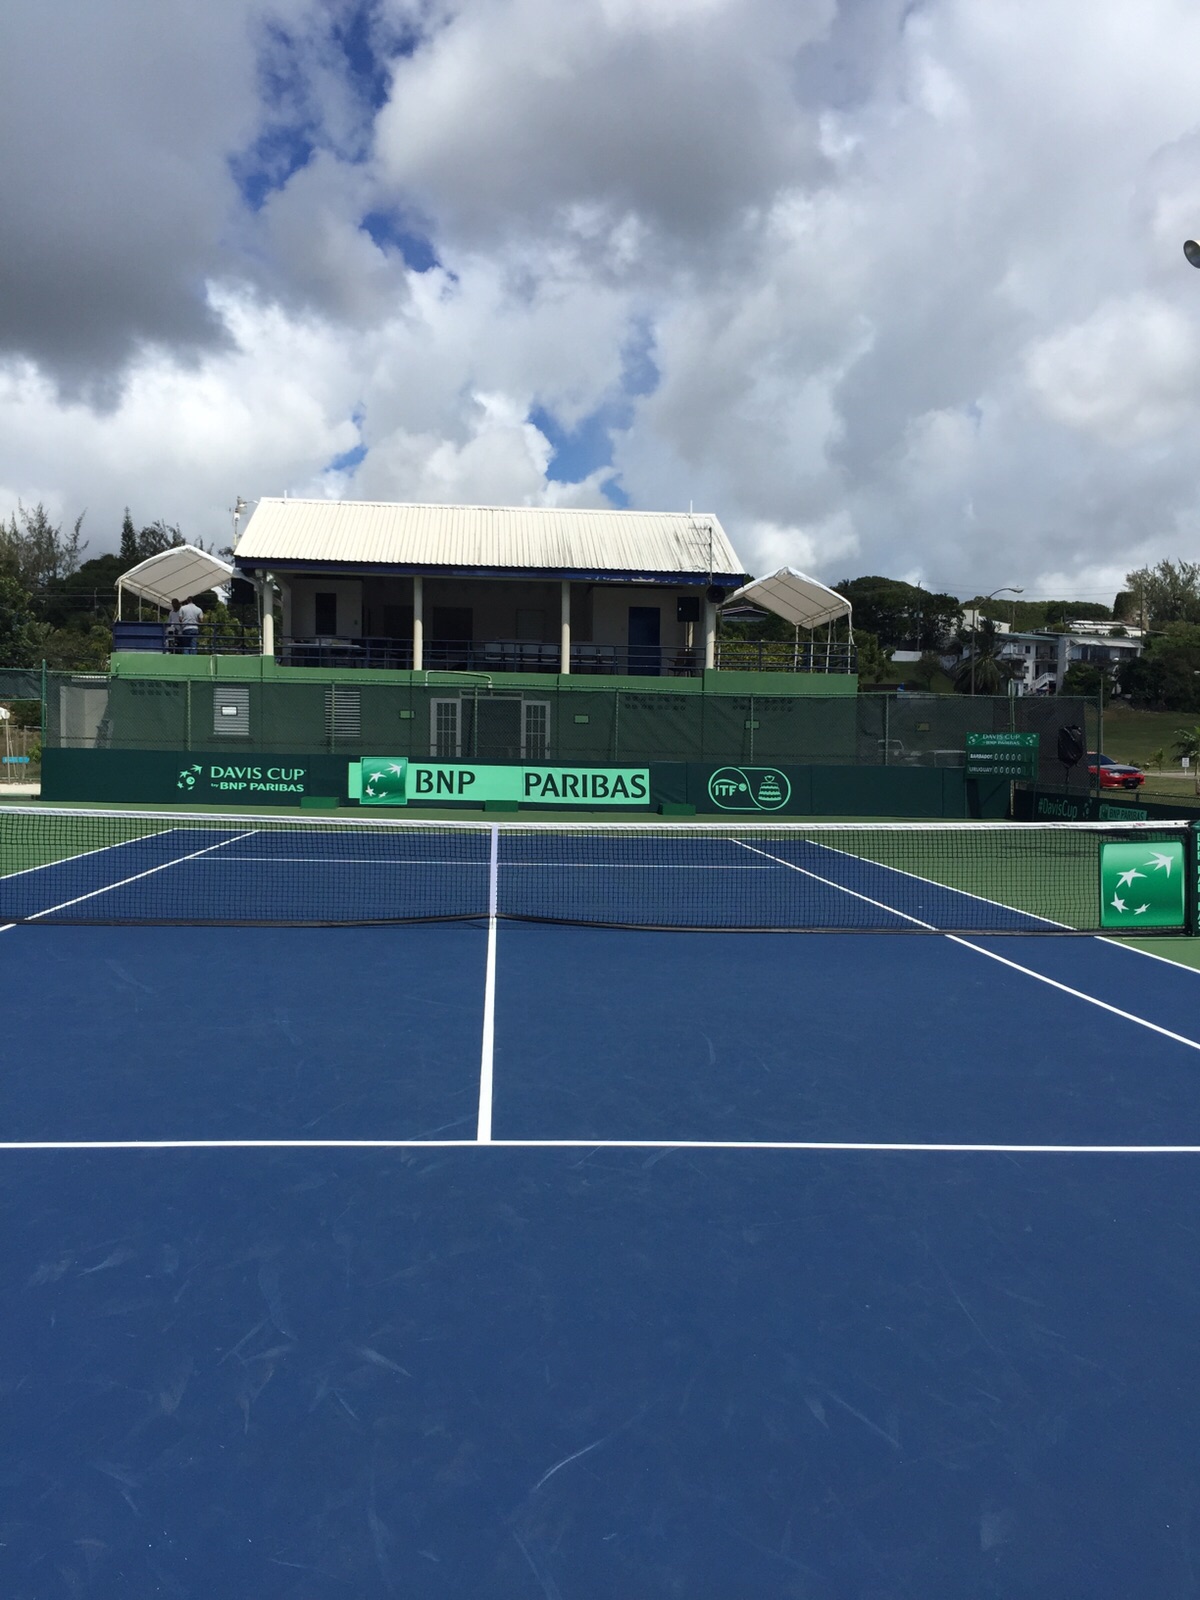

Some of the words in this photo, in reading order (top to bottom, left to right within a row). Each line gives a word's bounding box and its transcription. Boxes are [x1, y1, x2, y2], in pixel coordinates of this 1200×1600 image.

[211, 766, 262, 779] DAVIS
[267, 767, 305, 781] CUP
[220, 782, 247, 790] BNP
[249, 782, 305, 792] PARIBAS
[415, 769, 476, 794] BNP
[524, 772, 647, 799] PARIBAS
[715, 784, 737, 797] ITF
[1038, 798, 1078, 820] #DavisCup
[1109, 808, 1121, 820] BNP
[1121, 809, 1144, 821] PARIBAS
